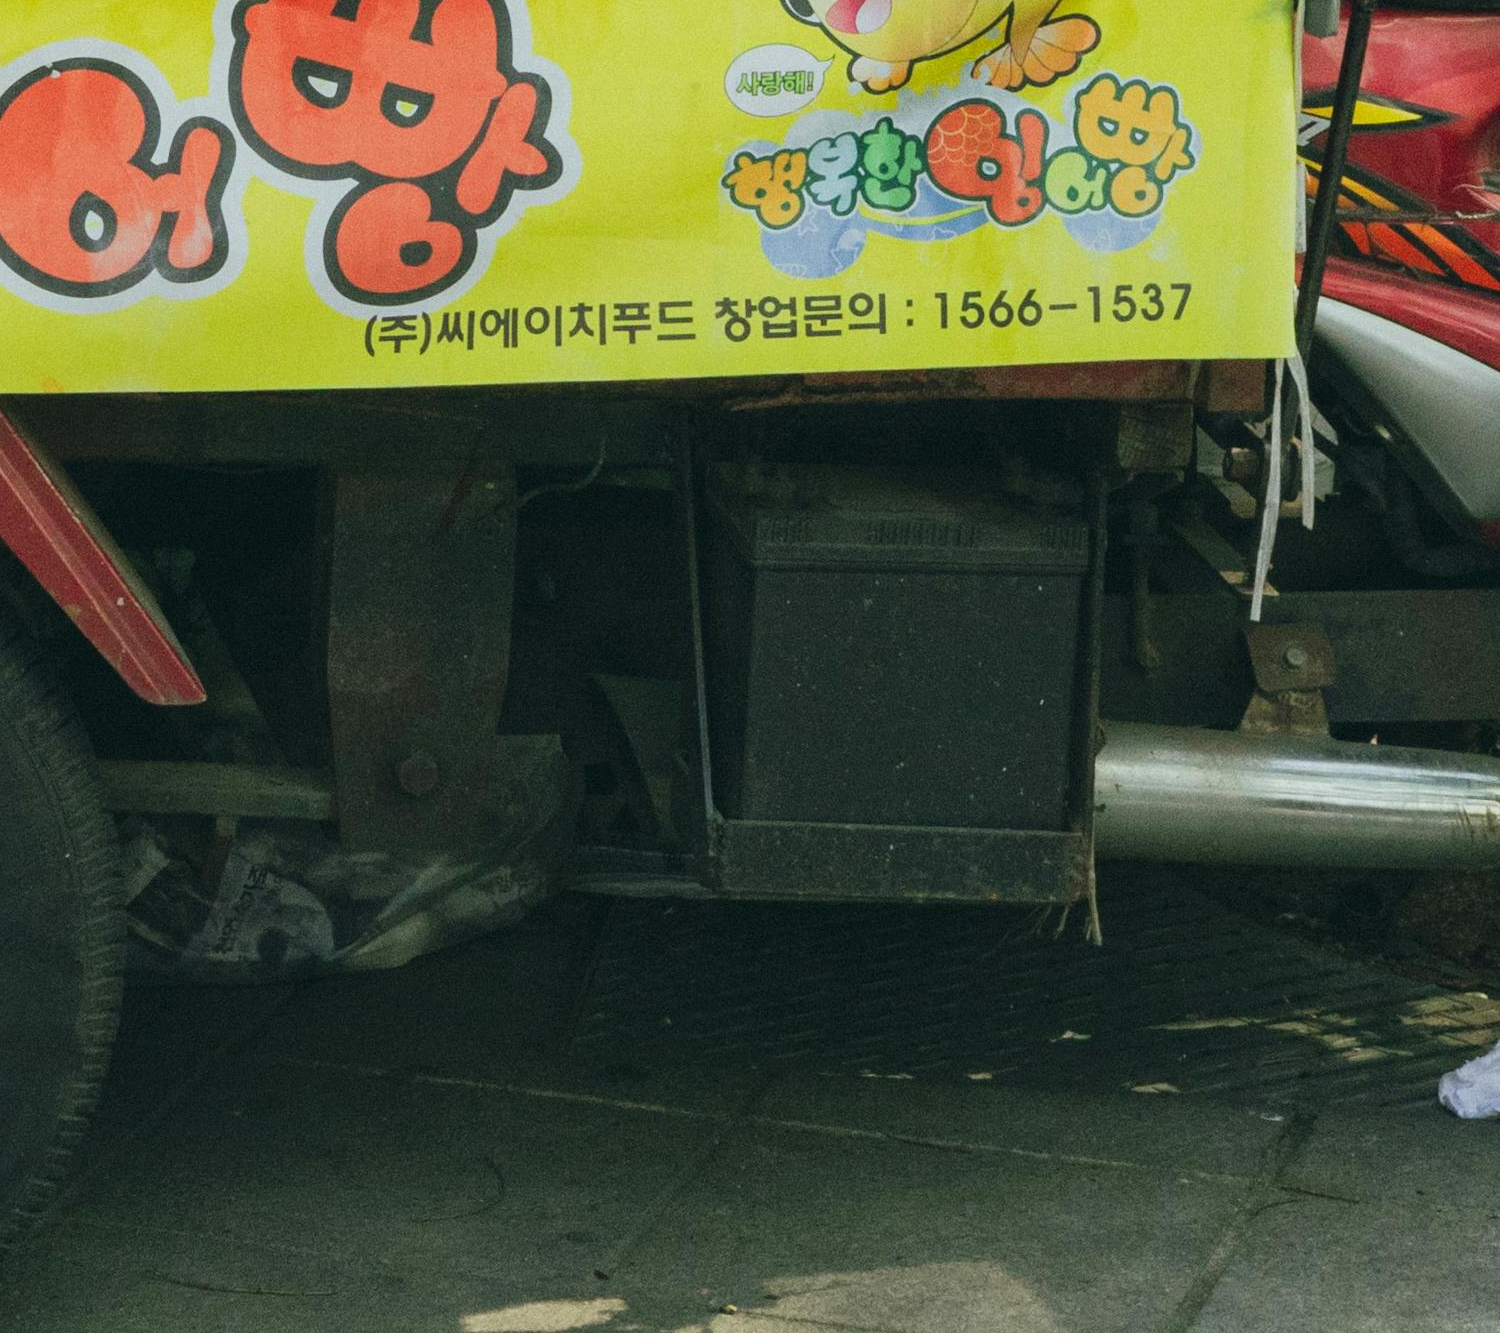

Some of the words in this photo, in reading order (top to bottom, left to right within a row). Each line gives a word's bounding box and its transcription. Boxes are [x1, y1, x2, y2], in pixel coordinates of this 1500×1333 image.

[735, 67, 816, 97] 사랑해!
[721, 116, 924, 230] 행복한
[923, 73, 1197, 228] 잉어빵
[364, 299, 697, 357] (주)씨에이치푸드
[714, 291, 888, 344] 창업문의
[932, 281, 1194, 331] 1566-1537
